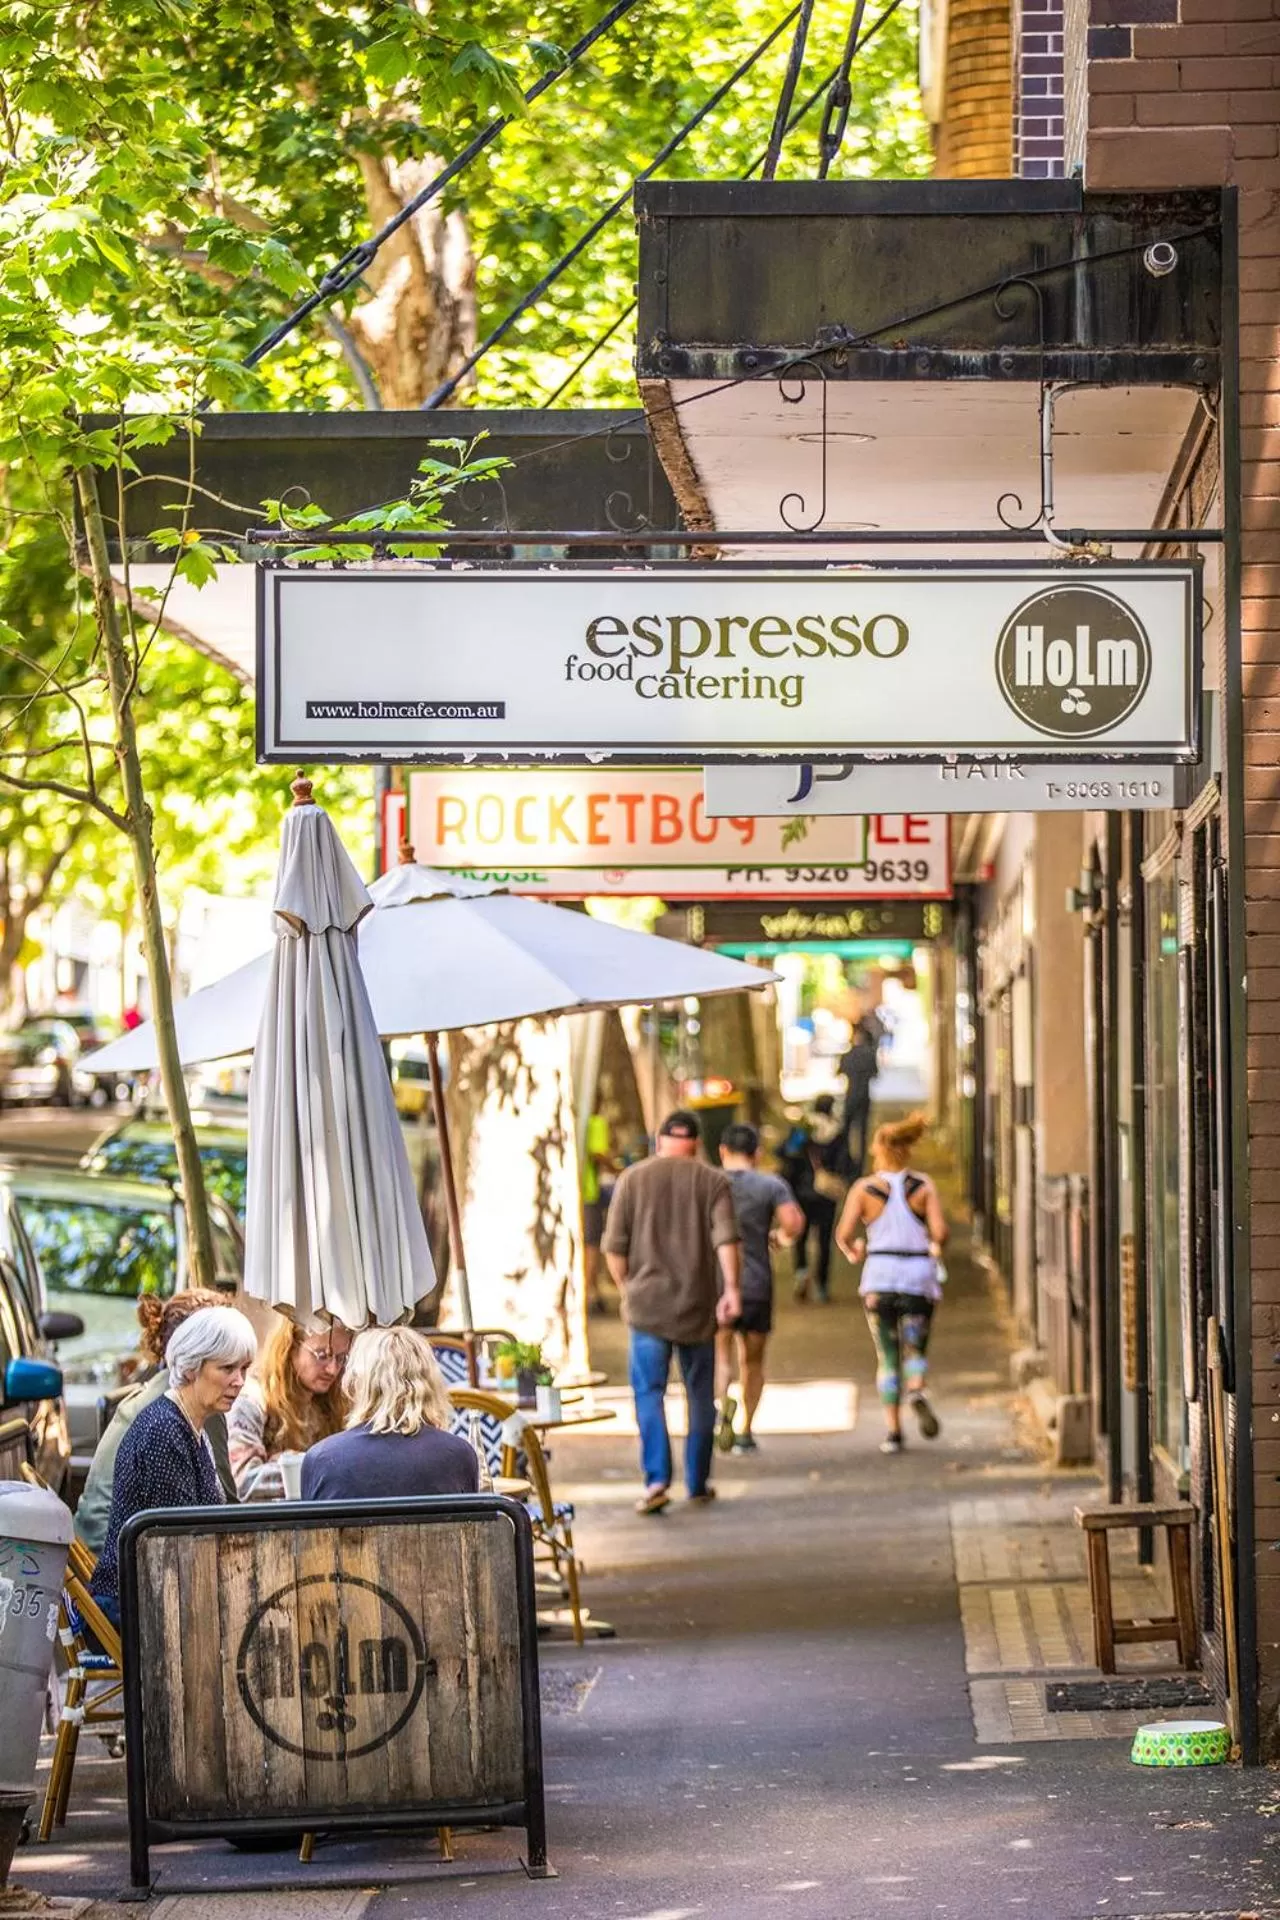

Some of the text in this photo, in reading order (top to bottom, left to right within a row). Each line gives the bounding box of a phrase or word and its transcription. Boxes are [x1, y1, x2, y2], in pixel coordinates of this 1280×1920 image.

[586, 614, 911, 675] espresso
[564, 654, 634, 681] food
[635, 665, 805, 708] catering
[311, 702, 499, 719] www.holmcafe.com.au
[941, 763, 1026, 780] HAIR
[1067, 781, 1111, 798] 8068
[1118, 780, 1161, 797] 1610
[863, 859, 930, 882] 9639
[11, 1587, 45, 1618] 35
